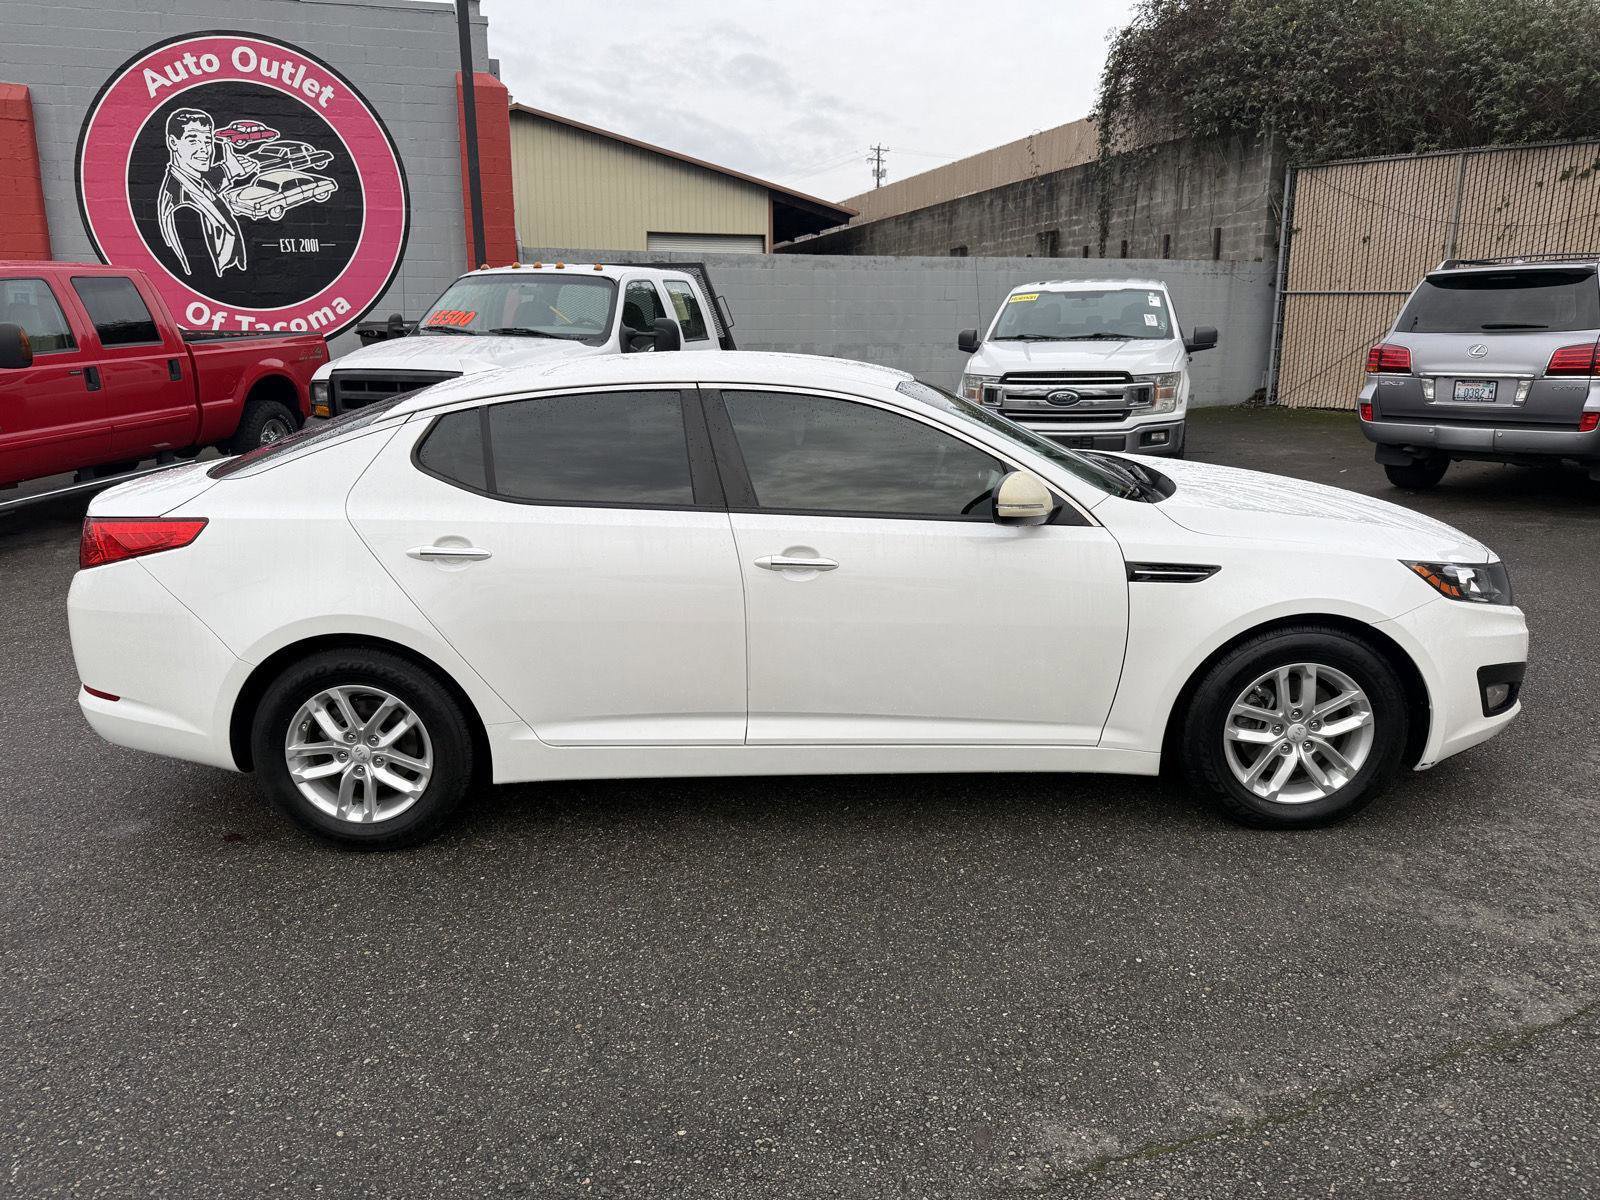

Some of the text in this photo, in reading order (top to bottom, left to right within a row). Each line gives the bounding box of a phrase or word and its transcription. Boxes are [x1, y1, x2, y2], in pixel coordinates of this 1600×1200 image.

[142, 46, 335, 109] Auto Outlet
[279, 238, 320, 253] EST. 2001
[185, 301, 228, 331] Of
